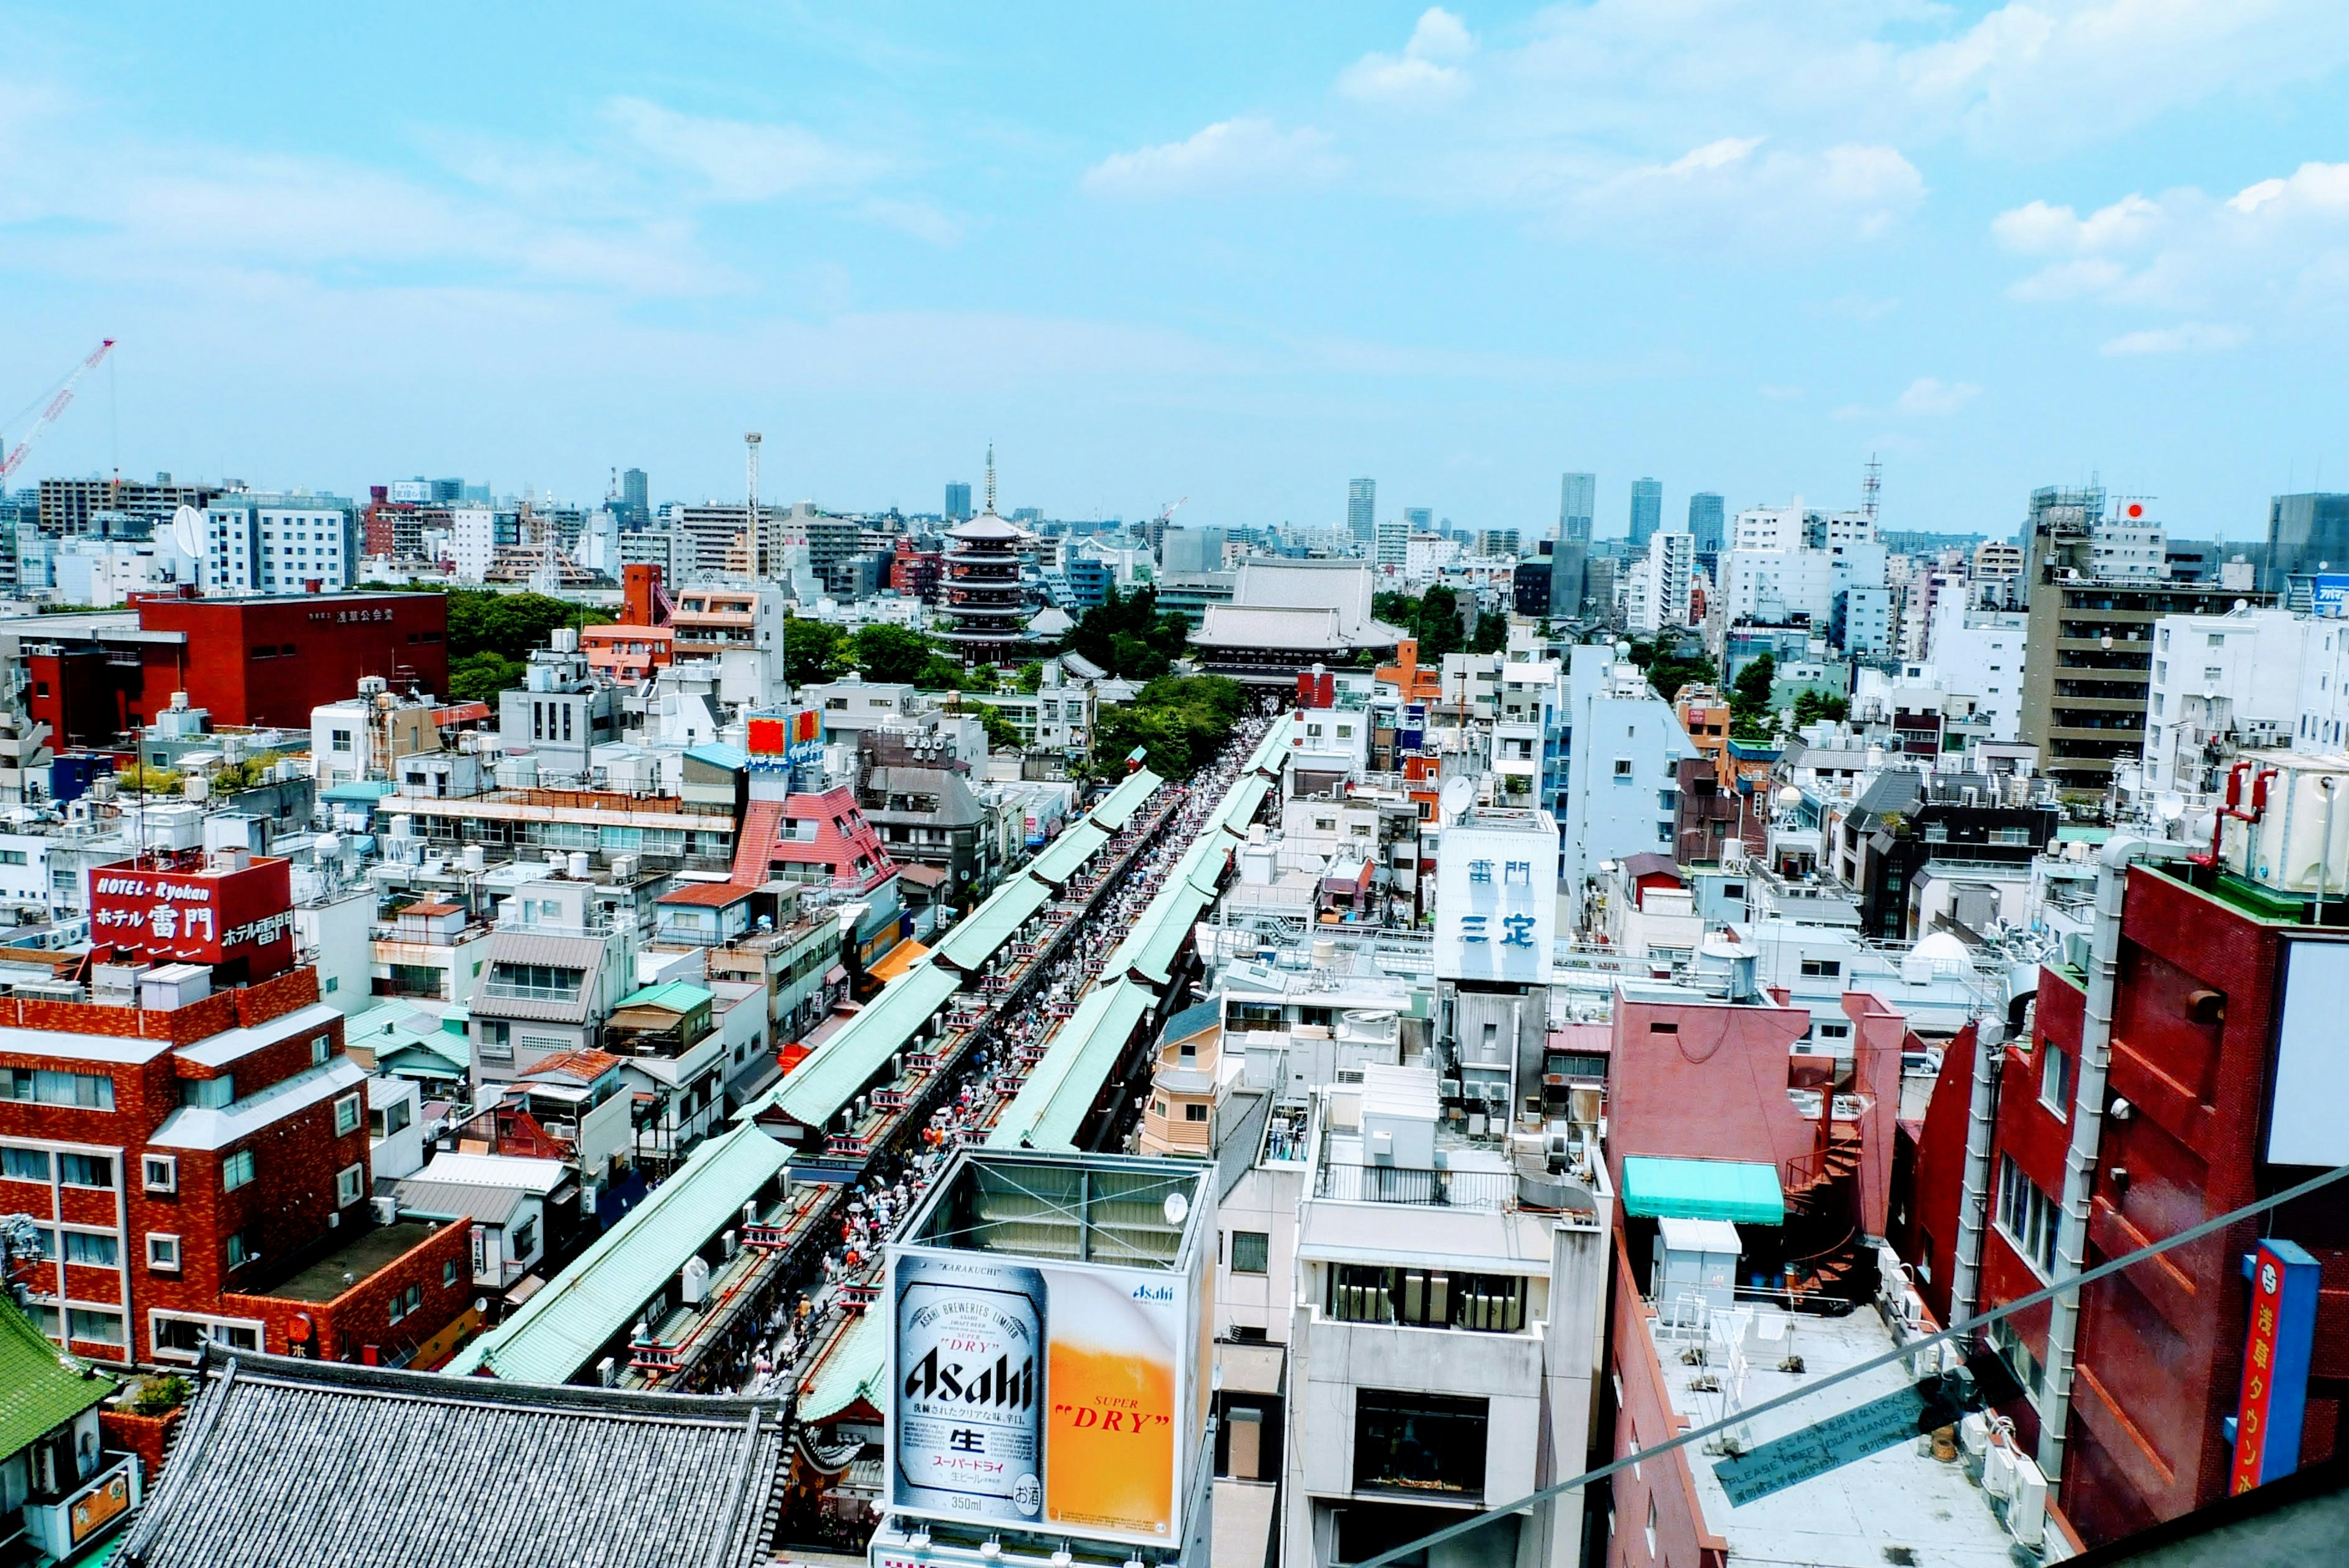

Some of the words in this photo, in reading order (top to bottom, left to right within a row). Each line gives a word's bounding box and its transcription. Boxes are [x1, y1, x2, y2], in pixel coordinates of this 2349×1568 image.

[1467, 859, 1531, 887] 雷門
[155, 881, 210, 901] Ryokan
[95, 904, 213, 942] ホテル雷門
[221, 910, 294, 946] ホテル雷門
[1457, 913, 1536, 949] 三定
[1133, 1284, 1173, 1301] Asahi
[920, 1308, 941, 1329] ASAHI
[943, 1302, 990, 1318] BREWERIES
[992, 1311, 1020, 1339] LIMITED
[905, 1346, 1033, 1413] Asahi
[1094, 1395, 1138, 1409] SUPER
[950, 1429, 985, 1454] 生
[1727, 1460, 1779, 1487] PLEASE
[1856, 1413, 1901, 1435] HANDS
[933, 1456, 1003, 1473] スーパードライ
[951, 1471, 984, 1484] 生ビール
[952, 1496, 981, 1511] 350ml
[1015, 1485, 1039, 1506] お酒
